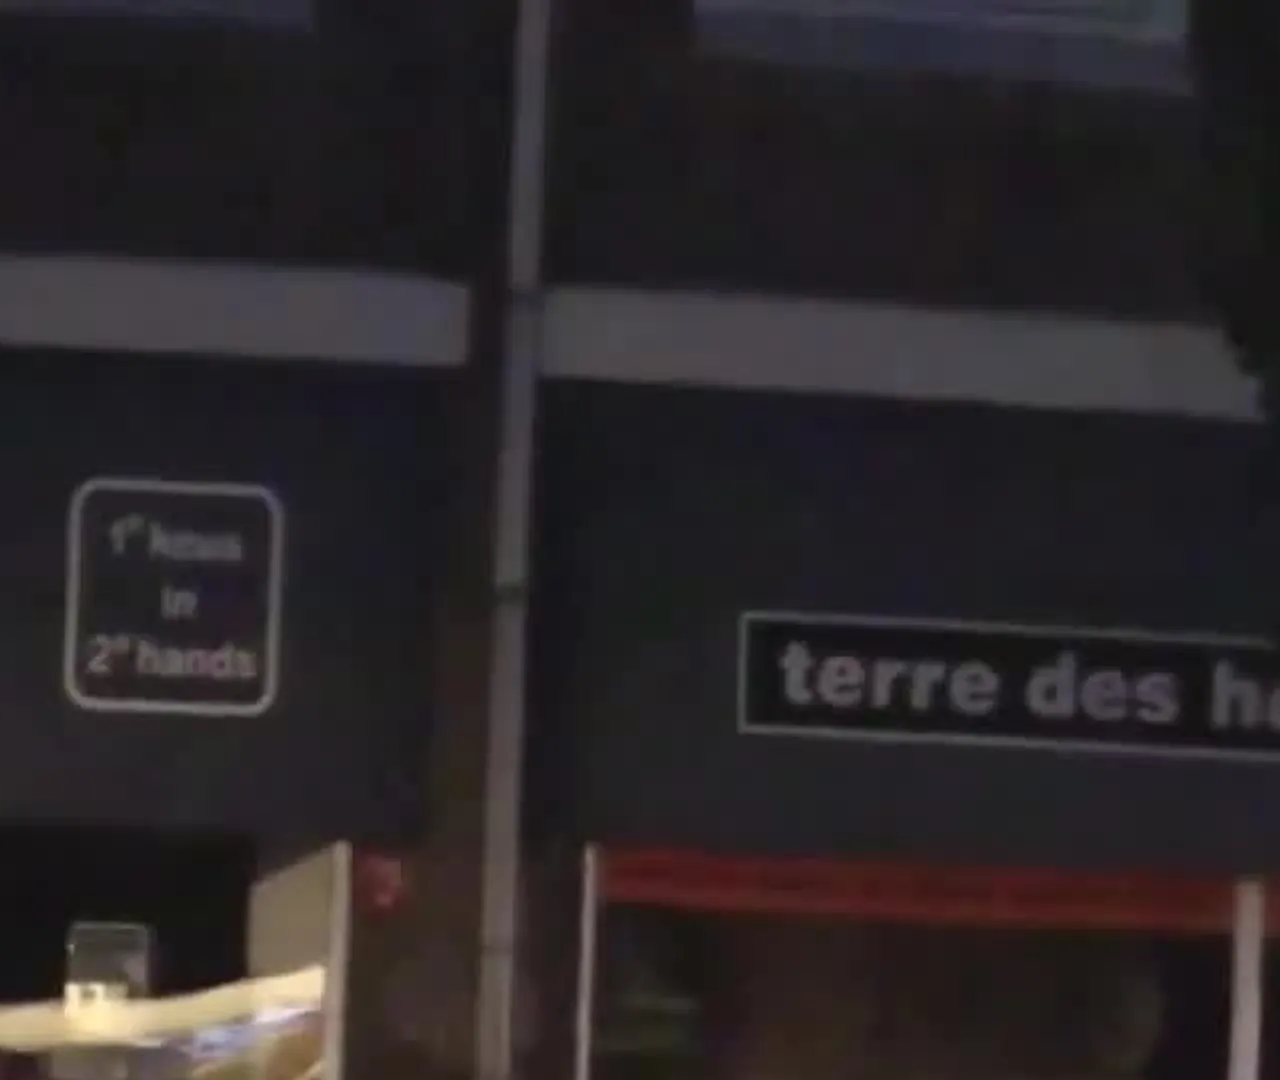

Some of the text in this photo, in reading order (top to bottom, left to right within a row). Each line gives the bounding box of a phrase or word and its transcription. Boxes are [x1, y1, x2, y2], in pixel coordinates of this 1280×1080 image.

[135, 638, 258, 680] hands
[777, 639, 1001, 716] terre
[1025, 649, 1183, 726] des
